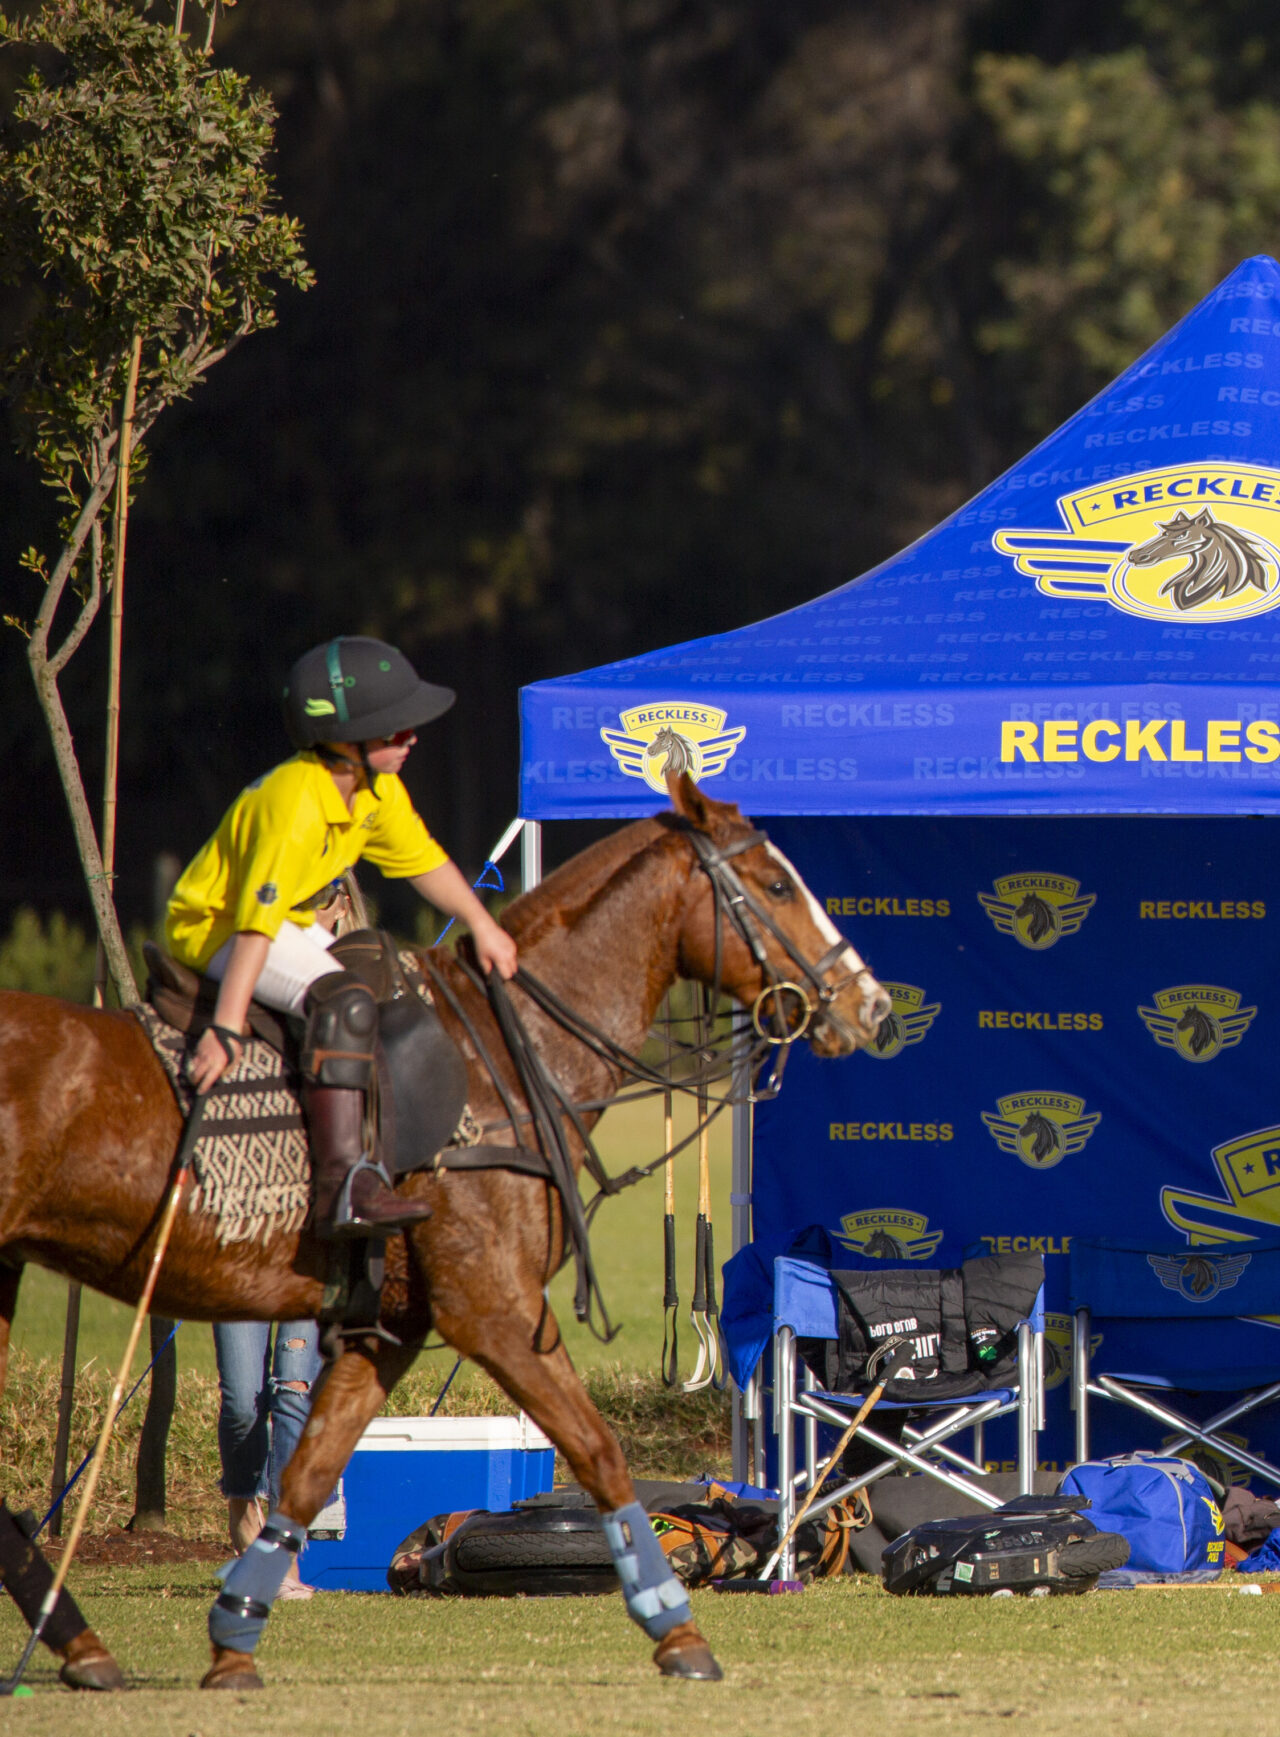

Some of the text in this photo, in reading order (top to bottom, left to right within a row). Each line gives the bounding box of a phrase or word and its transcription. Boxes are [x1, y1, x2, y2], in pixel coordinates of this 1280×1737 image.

[1084, 420, 1252, 449] RECKLESS
[813, 611, 987, 629] RECKLESS
[710, 636, 883, 650] RECKLESS
[936, 629, 1108, 644] RECKLESS
[796, 653, 969, 664] RECKLESS
[1022, 651, 1196, 663] RECKLESS
[690, 672, 865, 683] RECKLESS
[918, 671, 1093, 682] RECKLESS
[637, 709, 709, 724] RECKLESS
[781, 704, 955, 728] RECKLESS
[1008, 878, 1065, 892] RECKLESS
[826, 897, 950, 917] RECKLESS
[1140, 901, 1266, 919] RECKLESS
[1168, 991, 1226, 1004] RECKLESS
[978, 1011, 1104, 1030] RECKLESS
[1011, 1097, 1070, 1110] RECKLESS
[829, 1122, 954, 1141] RECKLESS
[855, 1214, 914, 1227] RECKLESS
